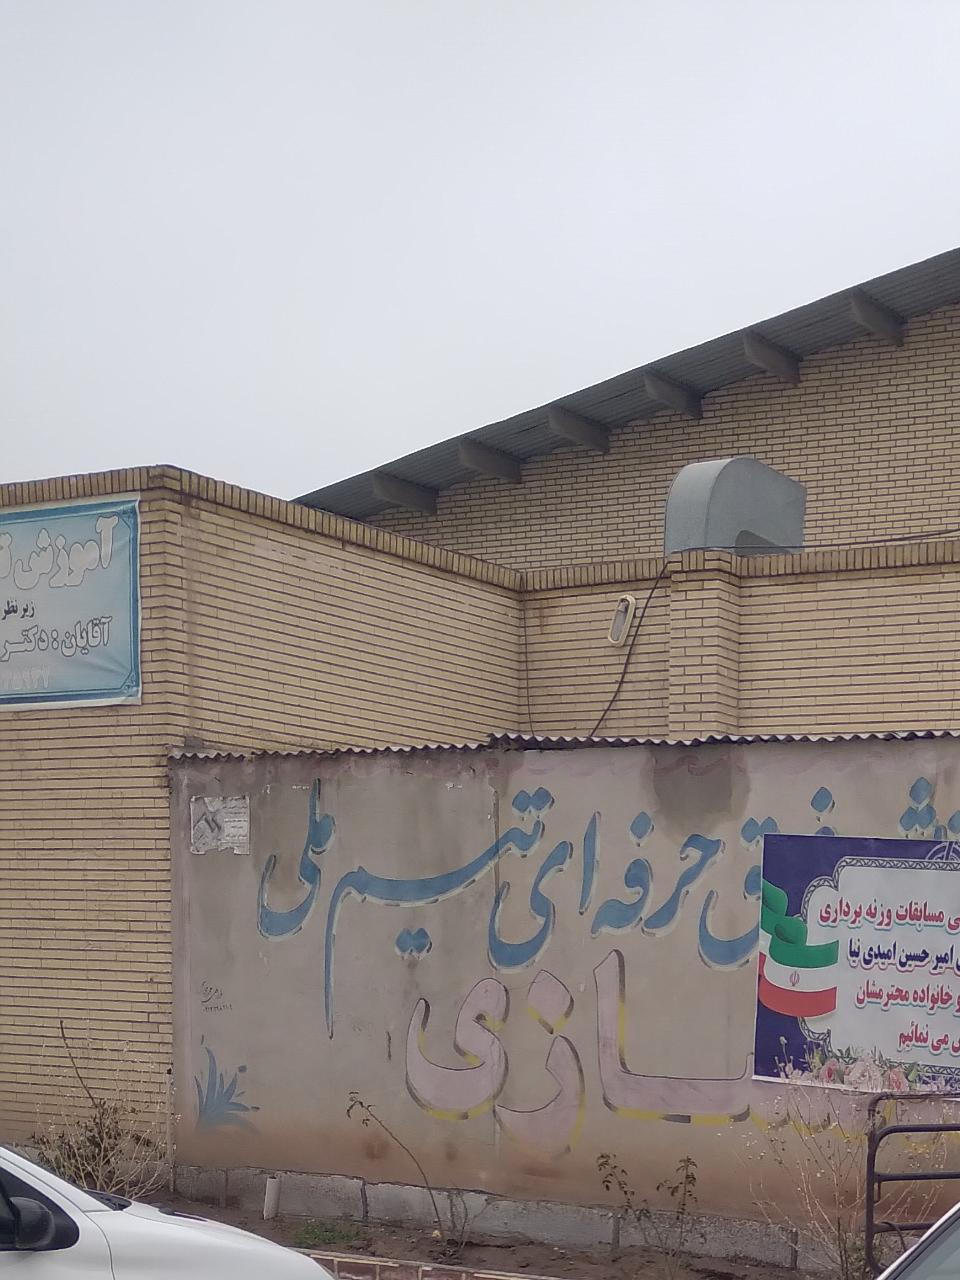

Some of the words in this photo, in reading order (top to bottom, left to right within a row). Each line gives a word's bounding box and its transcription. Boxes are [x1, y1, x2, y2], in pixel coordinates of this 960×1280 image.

[14, 515, 119, 590] آموزش
[2, 600, 18, 620] نظر
[20, 602, 35, 618] زیر
[591, 808, 727, 938] حرفه
[819, 897, 863, 925] برداری
[866, 898, 892, 926] وزنه
[895, 899, 944, 928] مسابقات
[849, 938, 861, 964] نیا
[863, 940, 897, 966] امیدی
[899, 947, 929, 968] حسین
[931, 944, 954, 970] امیر
[912, 983, 953, 1011] خانواده
[899, 1020, 929, 1048] نمائیم
[931, 1032, 949, 1051] می
